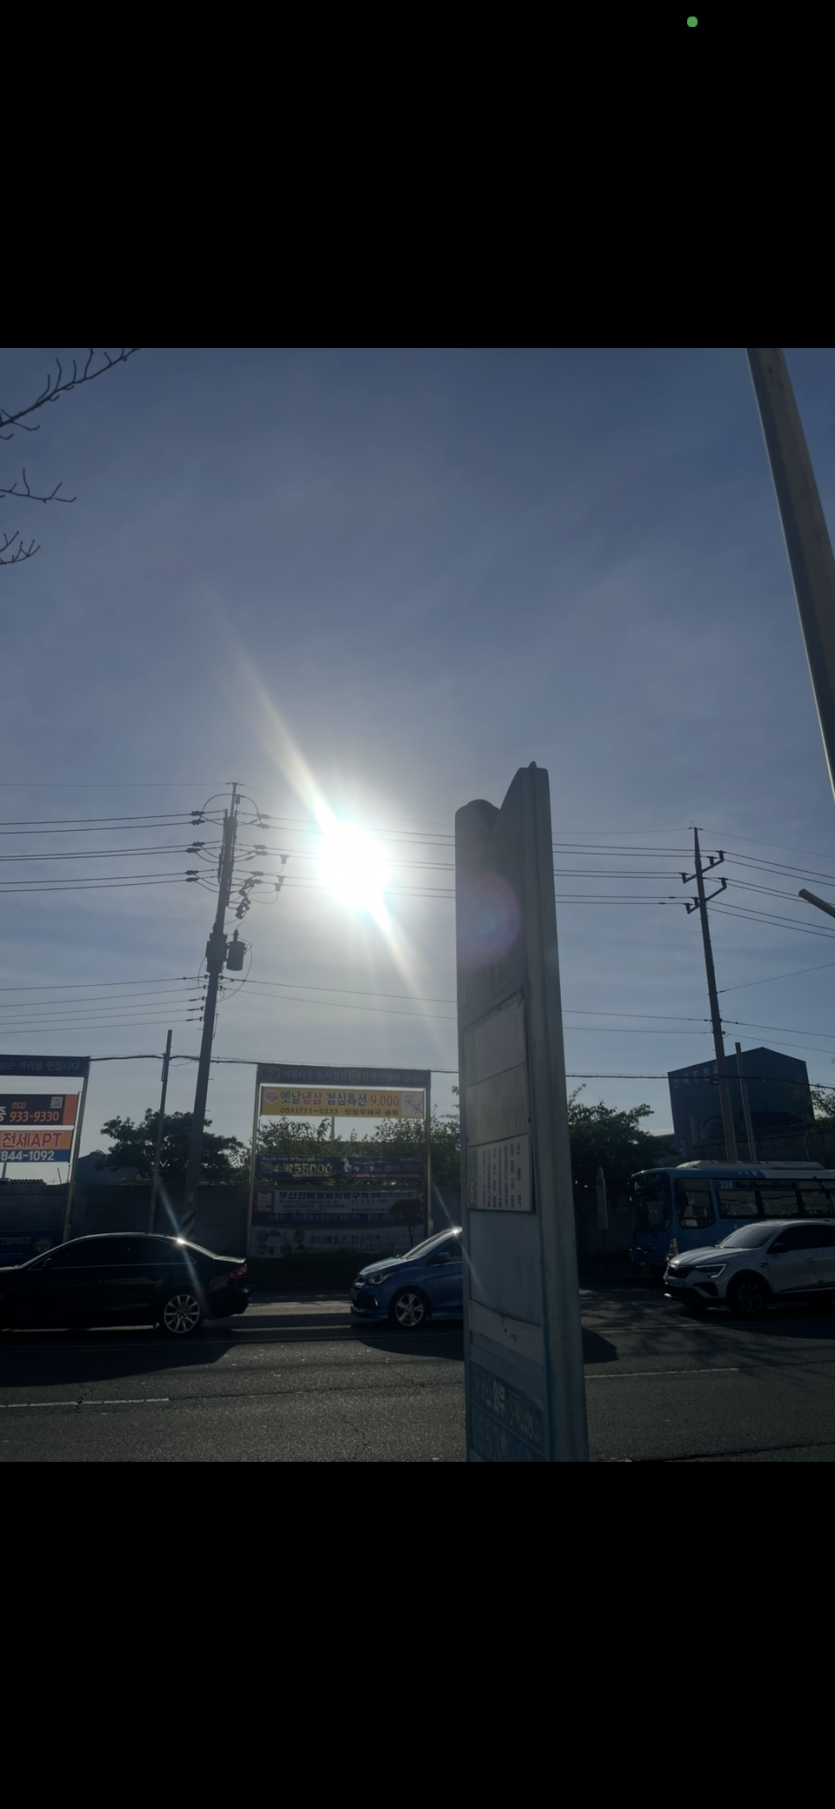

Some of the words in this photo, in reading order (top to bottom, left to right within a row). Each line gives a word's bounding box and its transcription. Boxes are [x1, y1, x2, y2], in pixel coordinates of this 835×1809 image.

[46, 1061, 80, 1072] 만듭니다
[282, 1069, 313, 1080] 아름다운
[316, 1070, 348, 1081] 도시경관
[379, 1072, 401, 1083] 만들어
[402, 1073, 424, 1084] 갑니다
[280, 1090, 323, 1105] 옛날냉삼
[326, 1092, 367, 1107] 점심특선
[370, 1094, 400, 1107] 9,000
[11, 1101, 26, 1110] 052)
[9, 1111, 60, 1123] 933-9330
[280, 1107, 339, 1115] 051)711-5333
[344, 1108, 381, 1116] 장림우체국
[2, 1132, 62, 1148] 전세APT
[0, 1150, 54, 1161] 844-1092
[719, 1181, 733, 1189] 338
